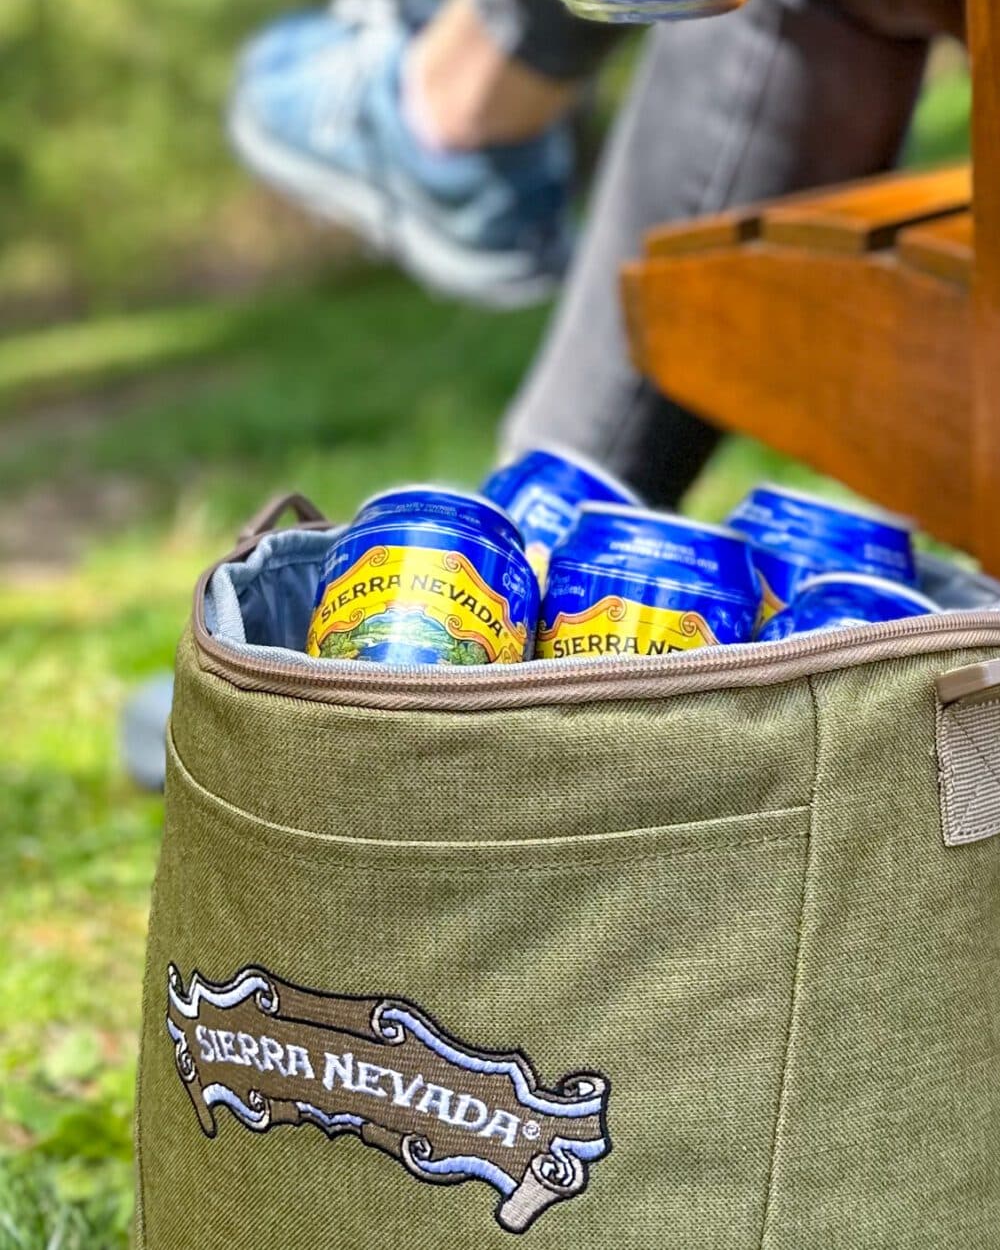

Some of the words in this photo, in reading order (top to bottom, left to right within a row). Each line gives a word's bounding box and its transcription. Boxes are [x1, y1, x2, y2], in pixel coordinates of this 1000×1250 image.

[321, 574, 401, 623] SIERRA
[410, 574, 504, 637] NEVADA
[553, 633, 639, 659] SIERRA
[195, 1025, 315, 1079] SIERRA
